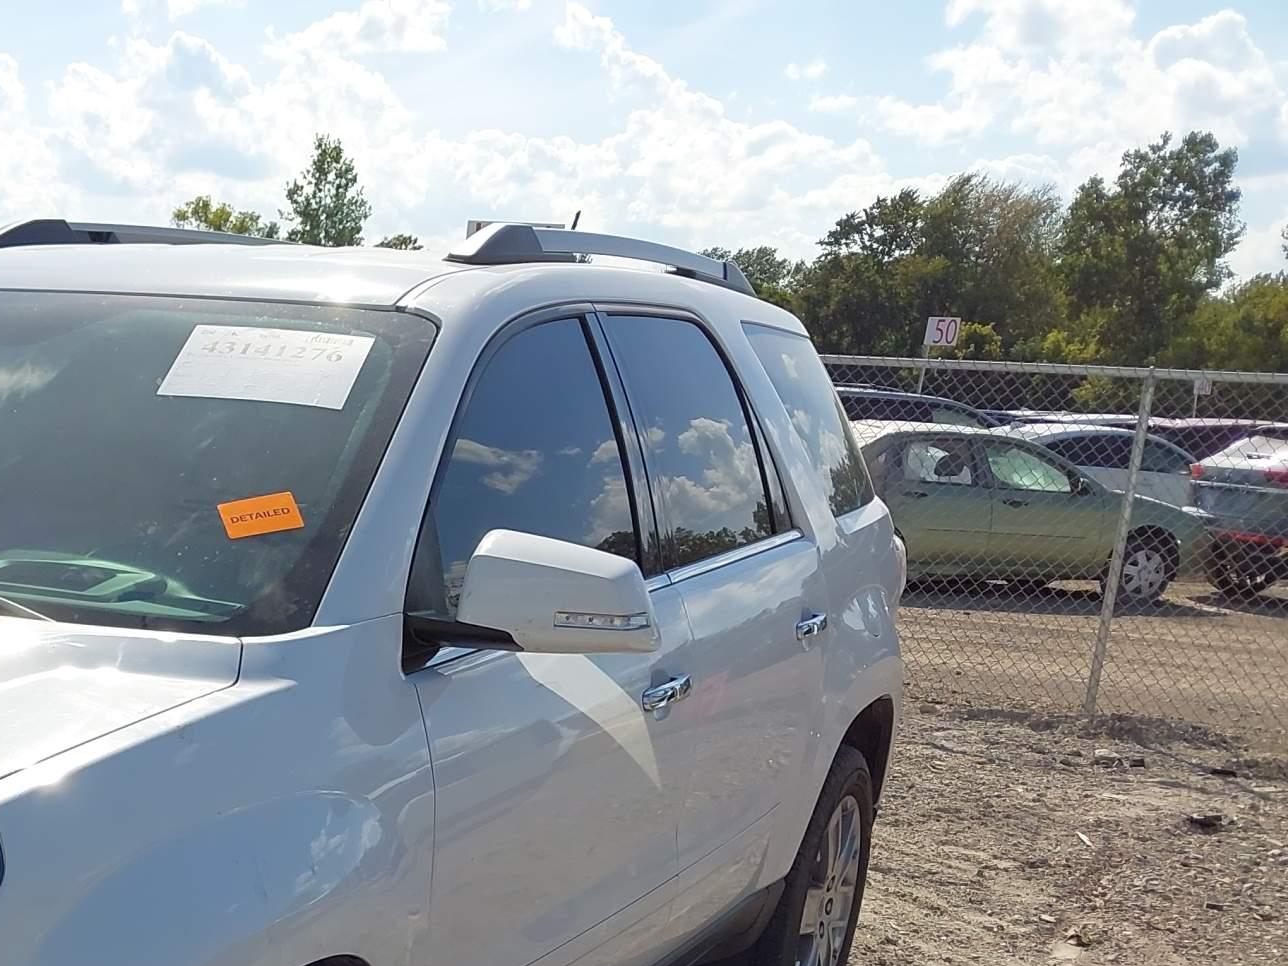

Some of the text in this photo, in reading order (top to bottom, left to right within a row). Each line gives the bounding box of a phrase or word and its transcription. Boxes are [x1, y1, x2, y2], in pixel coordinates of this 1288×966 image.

[932, 319, 957, 344] 50
[201, 340, 343, 362] 43141276
[230, 507, 290, 524] DETAILED
